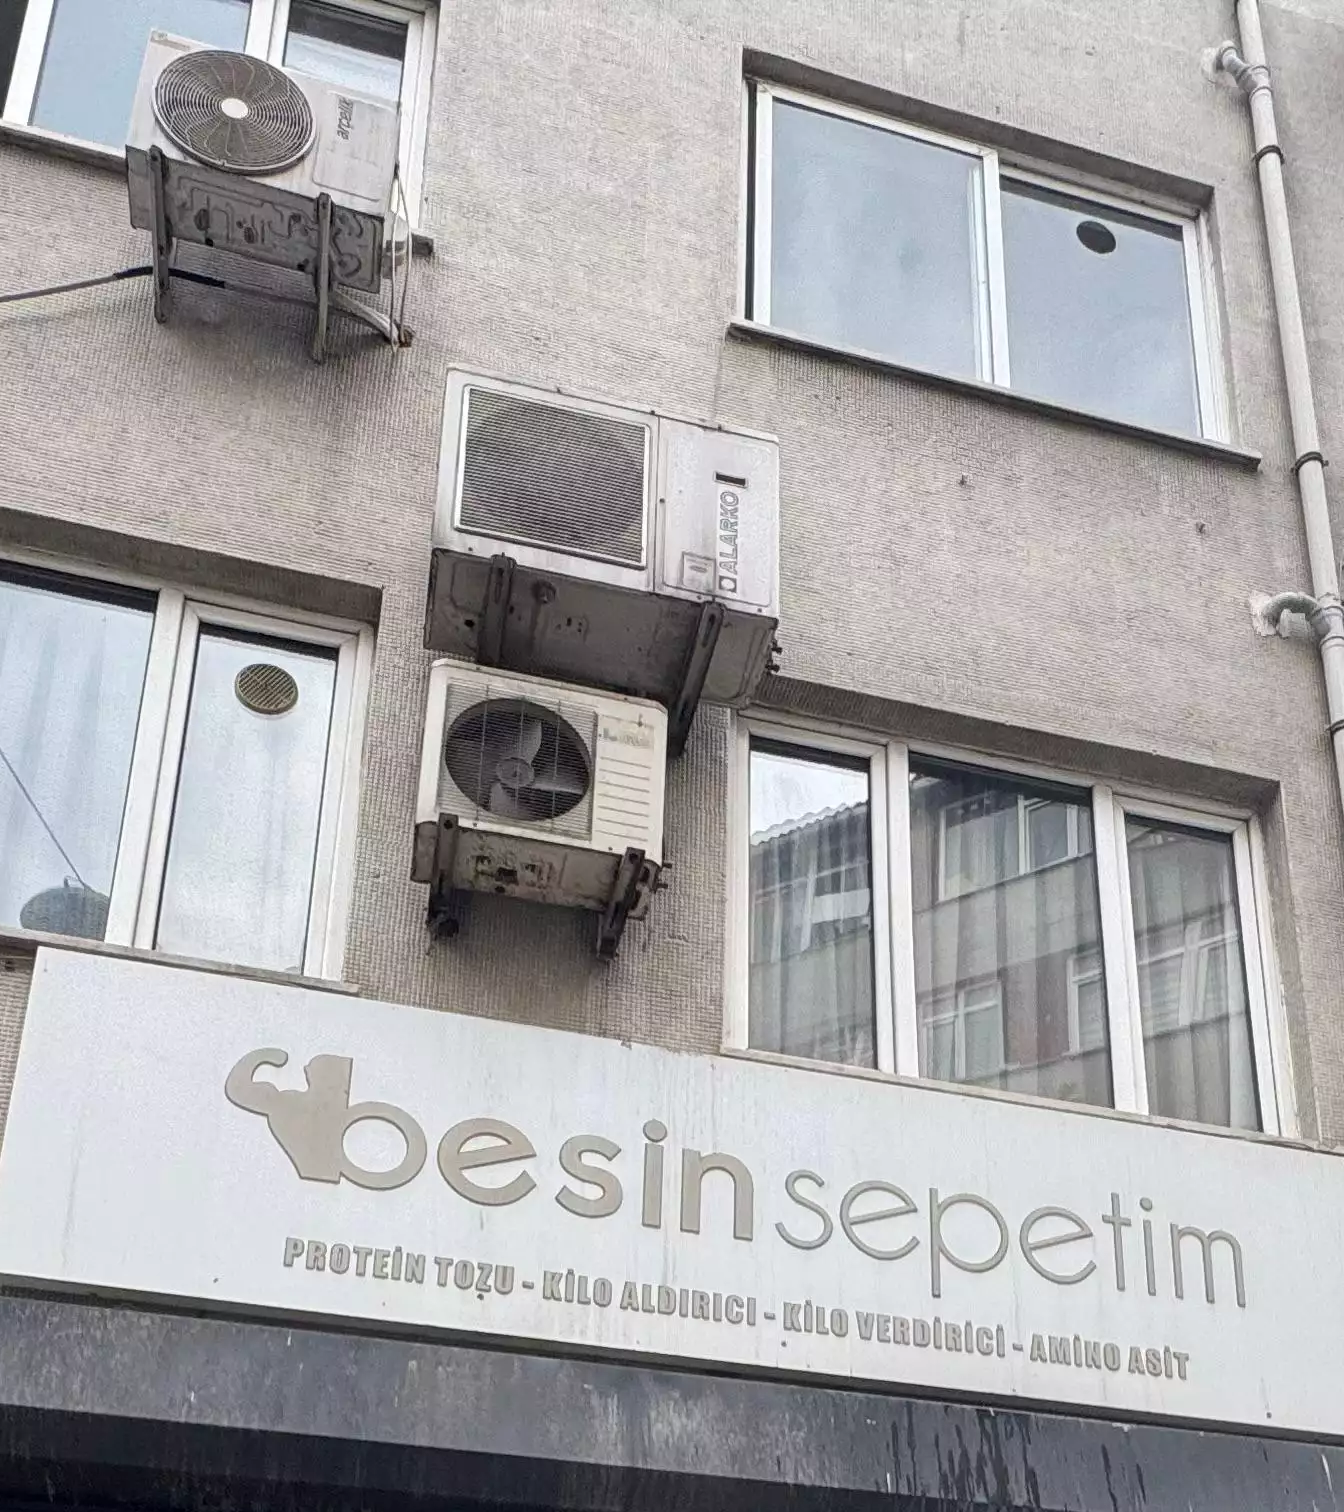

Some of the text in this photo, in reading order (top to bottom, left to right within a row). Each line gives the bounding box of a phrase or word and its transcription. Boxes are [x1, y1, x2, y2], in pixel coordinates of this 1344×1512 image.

[718, 490, 739, 576] ALARKO
[282, 1236, 427, 1285] PROTEİN
[433, 1256, 516, 1296] TOZU
[543, 1268, 613, 1308] KİLO
[619, 1281, 757, 1327] ALDIRICI
[783, 1299, 850, 1338] KİLO
[855, 1315, 1007, 1358] VERDİRİCİ
[1029, 1334, 1122, 1373] AMİNO
[1127, 1345, 1191, 1382] ASİT
